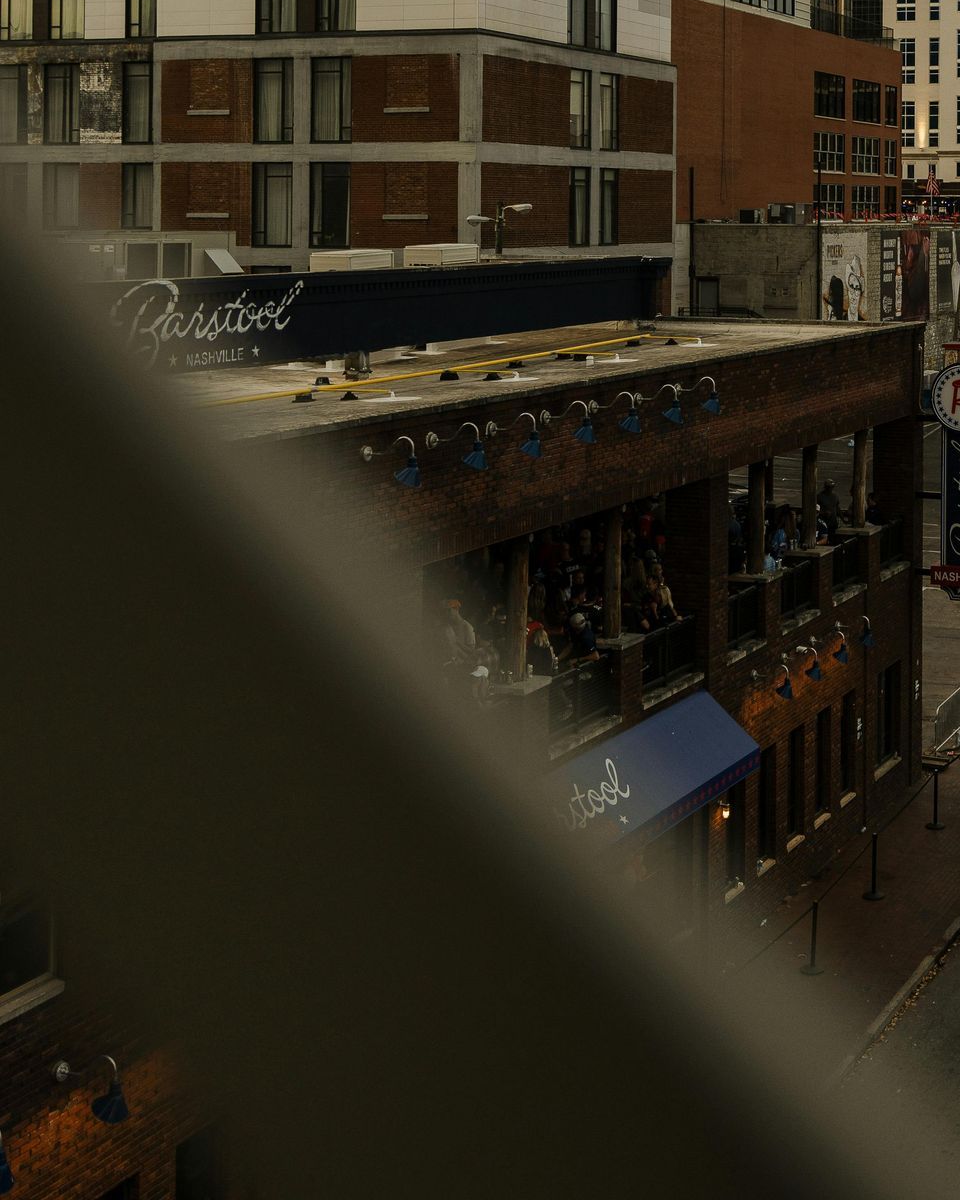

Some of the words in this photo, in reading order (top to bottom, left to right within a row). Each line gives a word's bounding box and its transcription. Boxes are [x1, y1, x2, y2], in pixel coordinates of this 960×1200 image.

[110, 280, 304, 371] Barstool
[186, 347, 244, 367] NASHVILLE
[568, 757, 630, 829] stool
